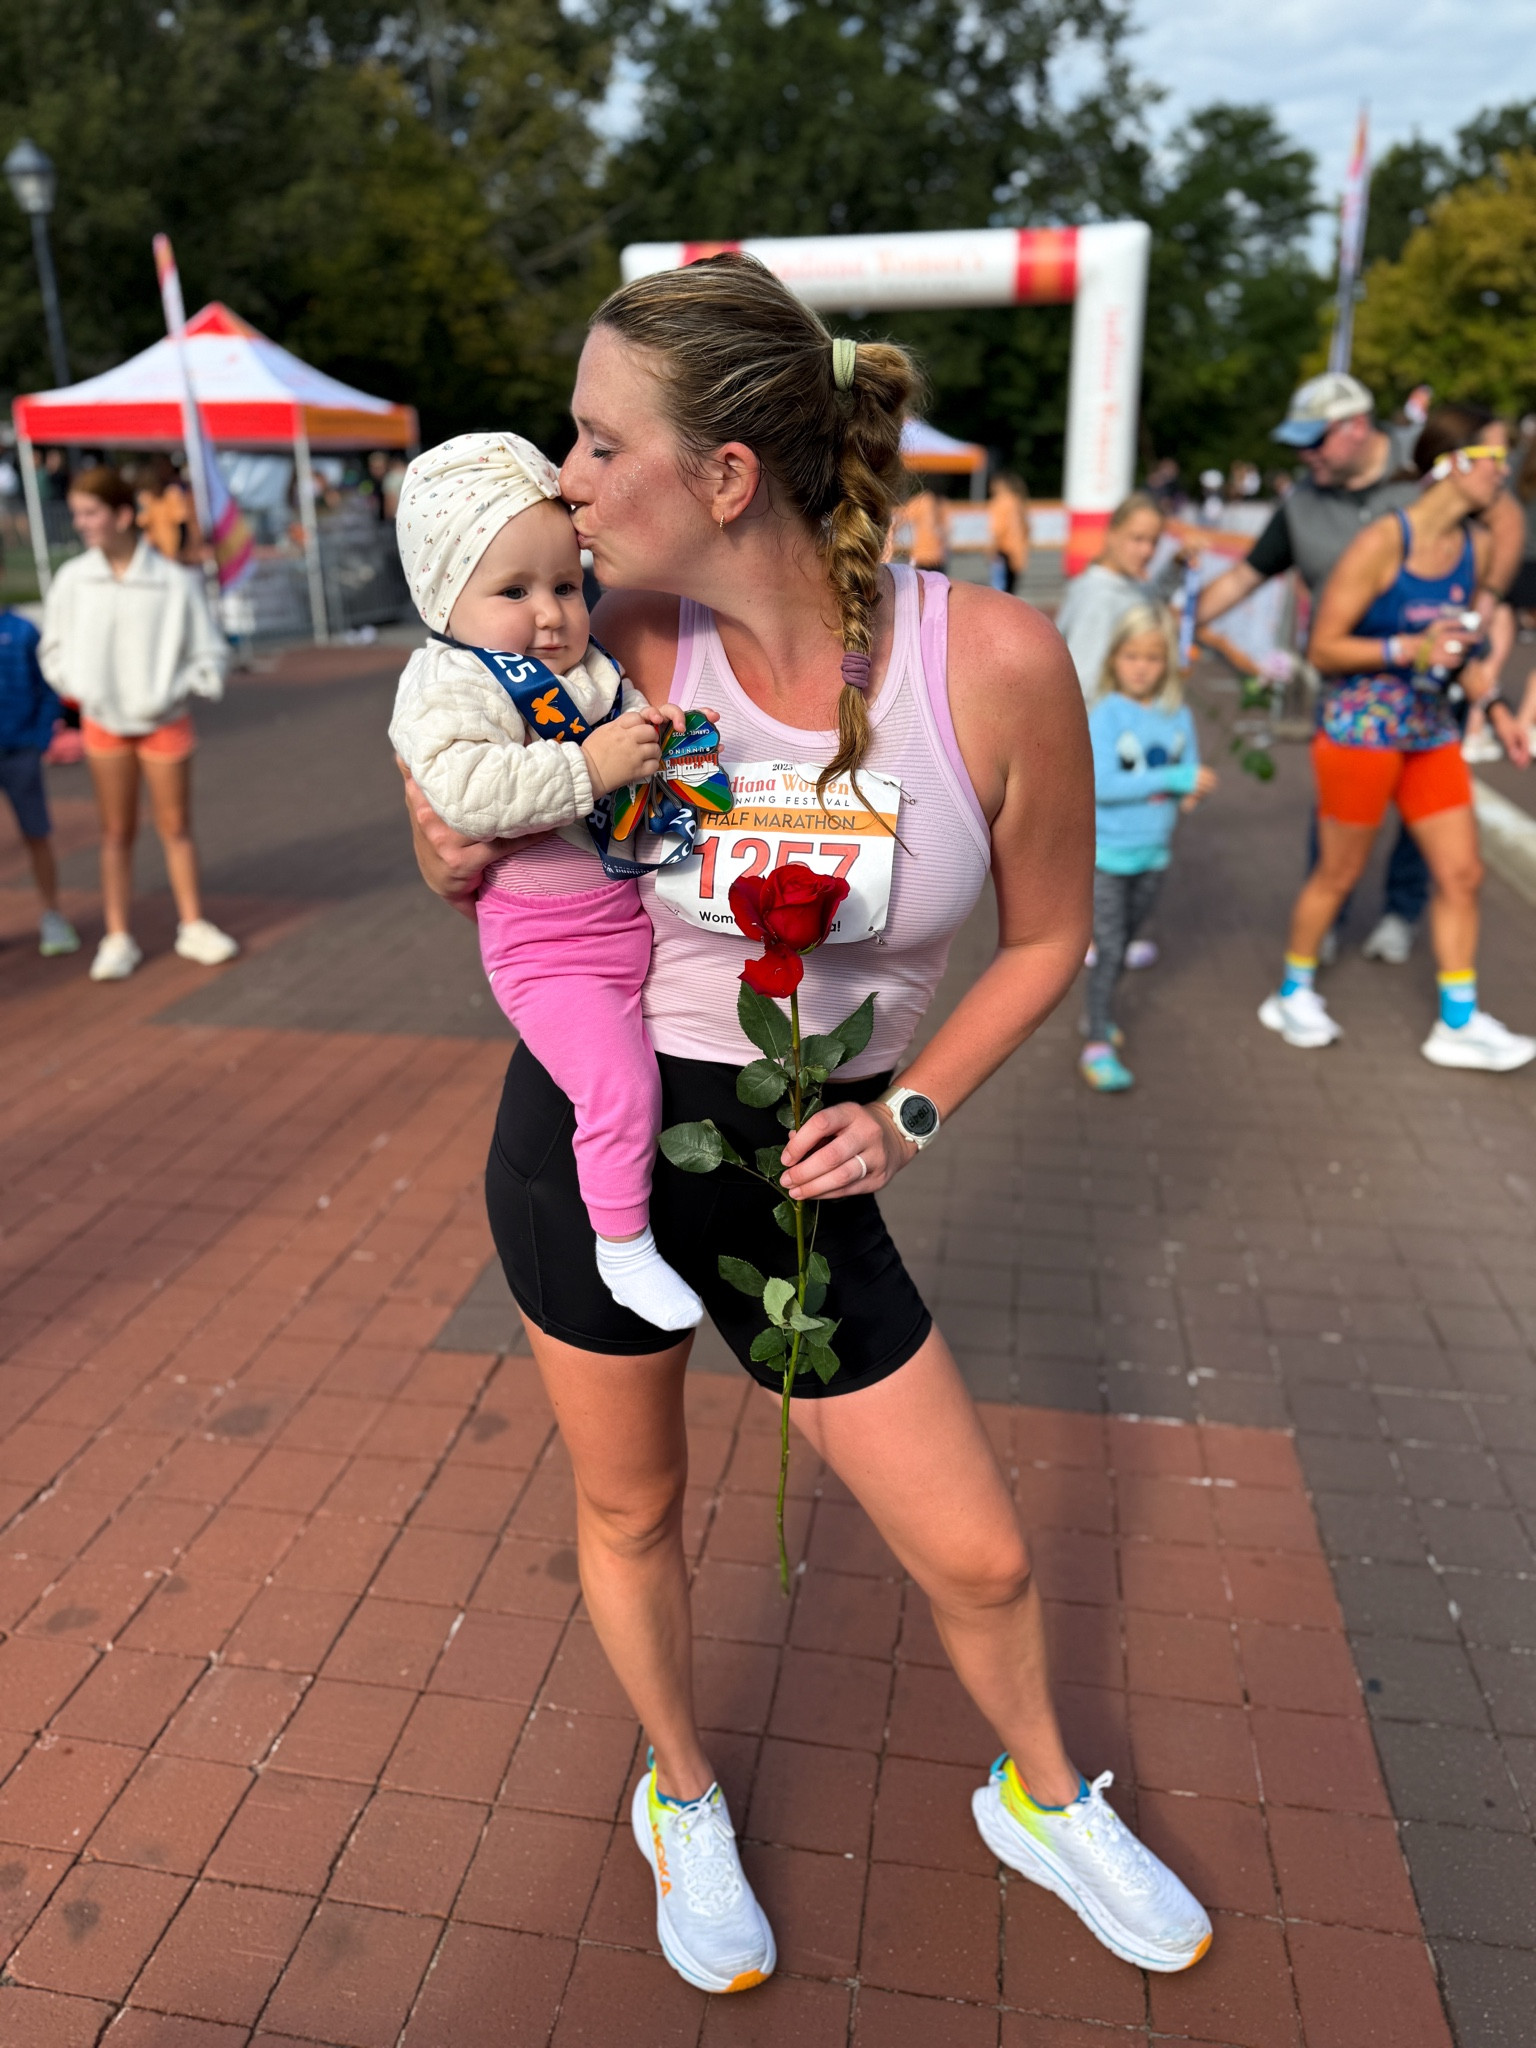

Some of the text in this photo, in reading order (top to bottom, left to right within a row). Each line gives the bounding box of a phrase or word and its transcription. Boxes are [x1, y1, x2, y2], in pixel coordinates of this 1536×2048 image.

[690, 728, 710, 736] CARMEL
[668, 746, 710, 755] RUNNING
[669, 753, 717, 769] Indiana
[730, 773, 863, 796] diana Women
[735, 796, 850, 807] NNING FESTVAL
[706, 812, 856, 830] HALF MARATHON
[651, 1822, 673, 1899] HOKA
